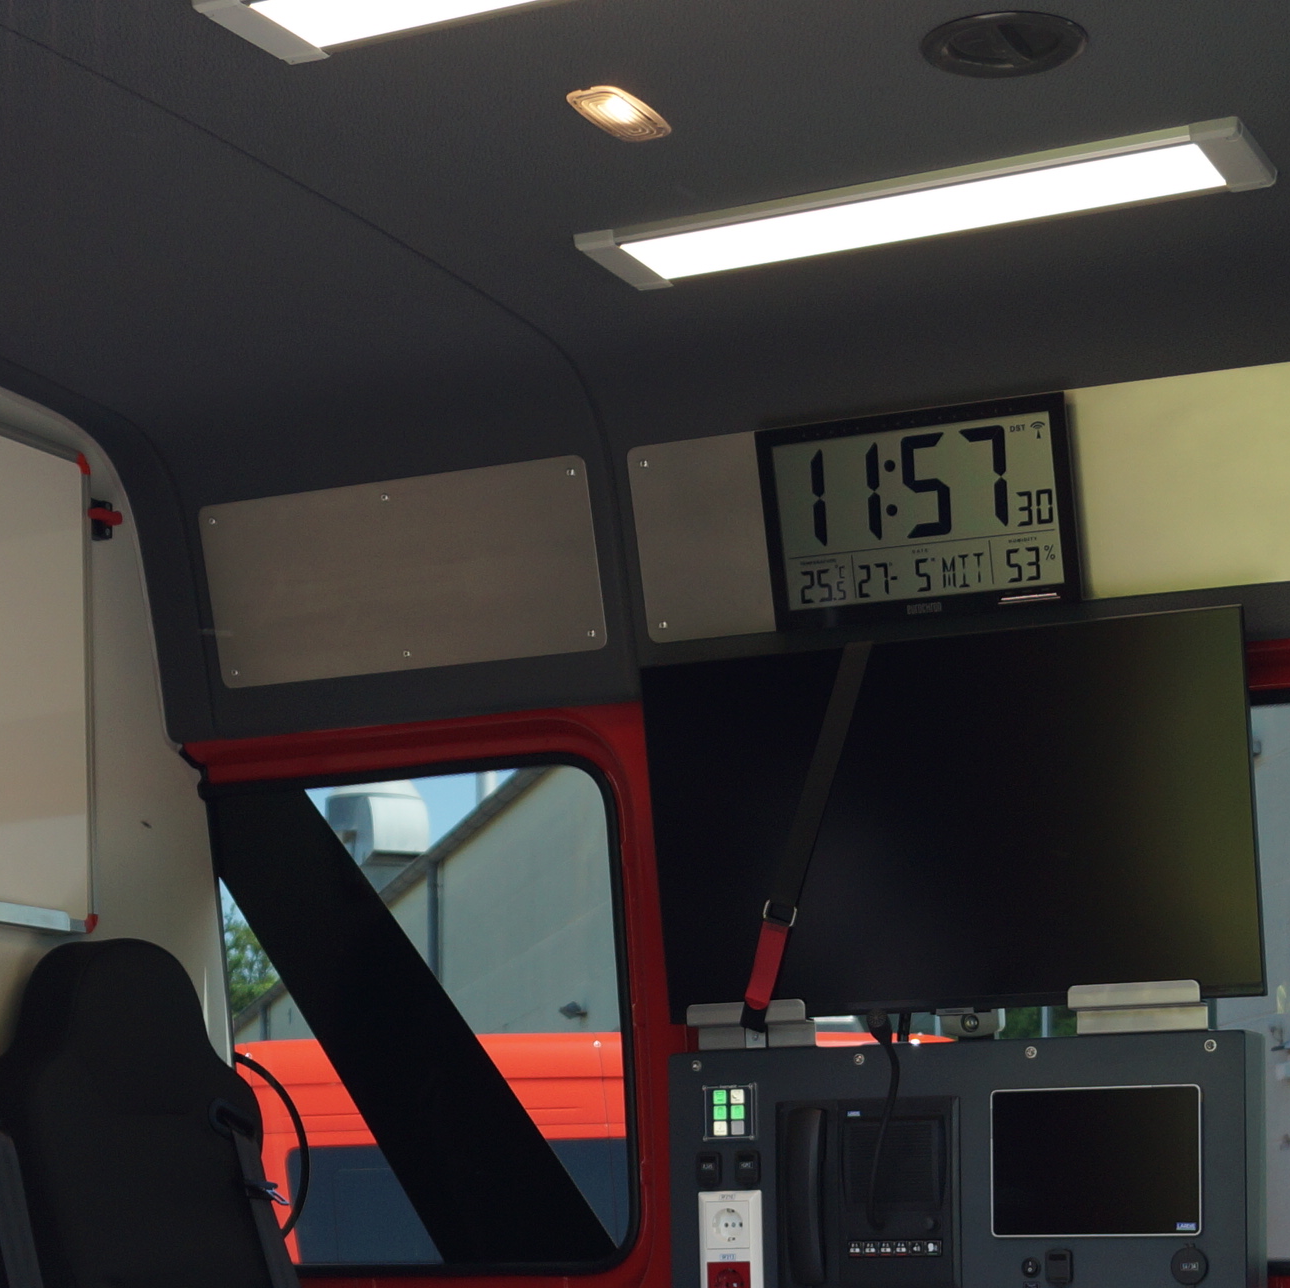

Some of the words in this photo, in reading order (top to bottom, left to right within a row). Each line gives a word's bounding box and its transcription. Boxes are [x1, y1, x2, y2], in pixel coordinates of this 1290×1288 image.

[1009, 423, 1026, 433] DST
[810, 425, 1009, 547] 11:57
[1016, 488, 1054, 527] 30
